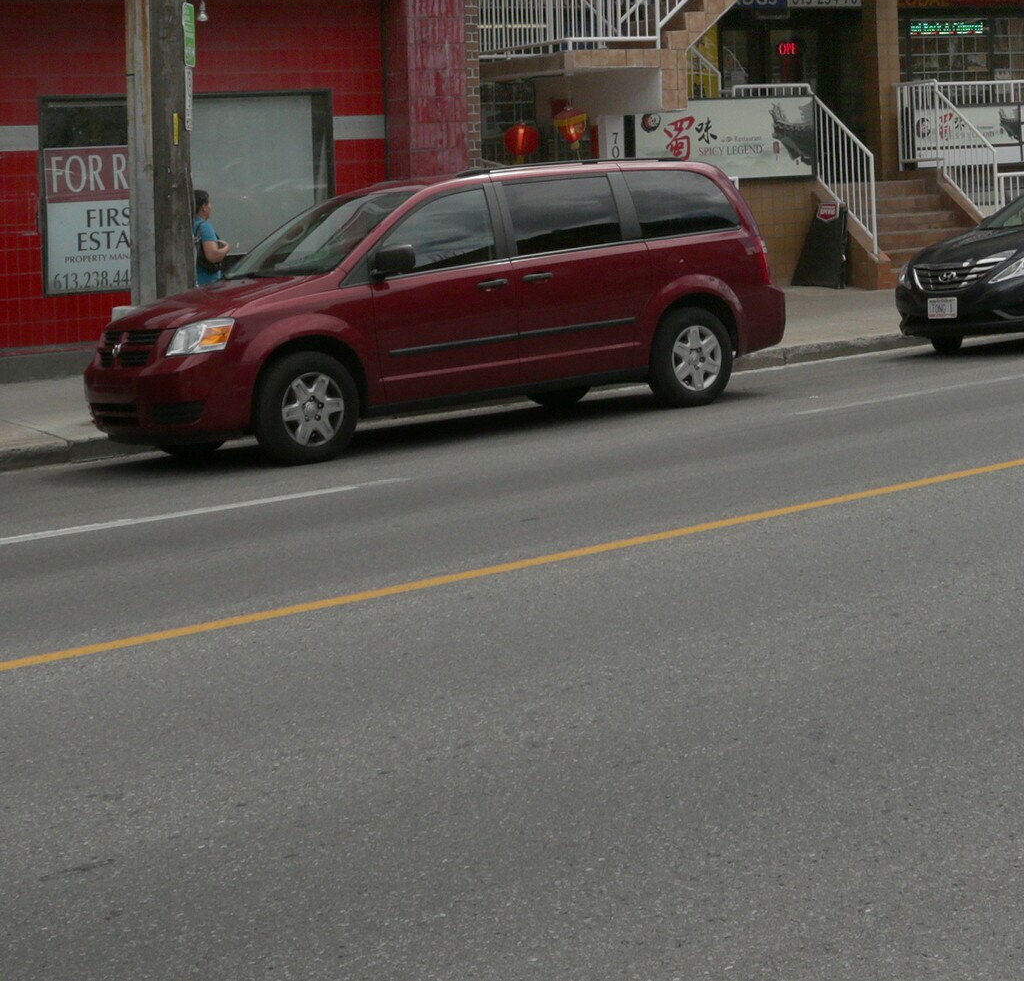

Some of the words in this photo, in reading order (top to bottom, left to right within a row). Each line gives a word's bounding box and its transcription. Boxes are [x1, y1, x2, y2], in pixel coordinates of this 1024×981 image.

[699, 147, 723, 156] SPICY
[726, 145, 763, 155] LEGEND
[51, 154, 105, 193] FOR
[64, 254, 107, 264] PROPERTY
